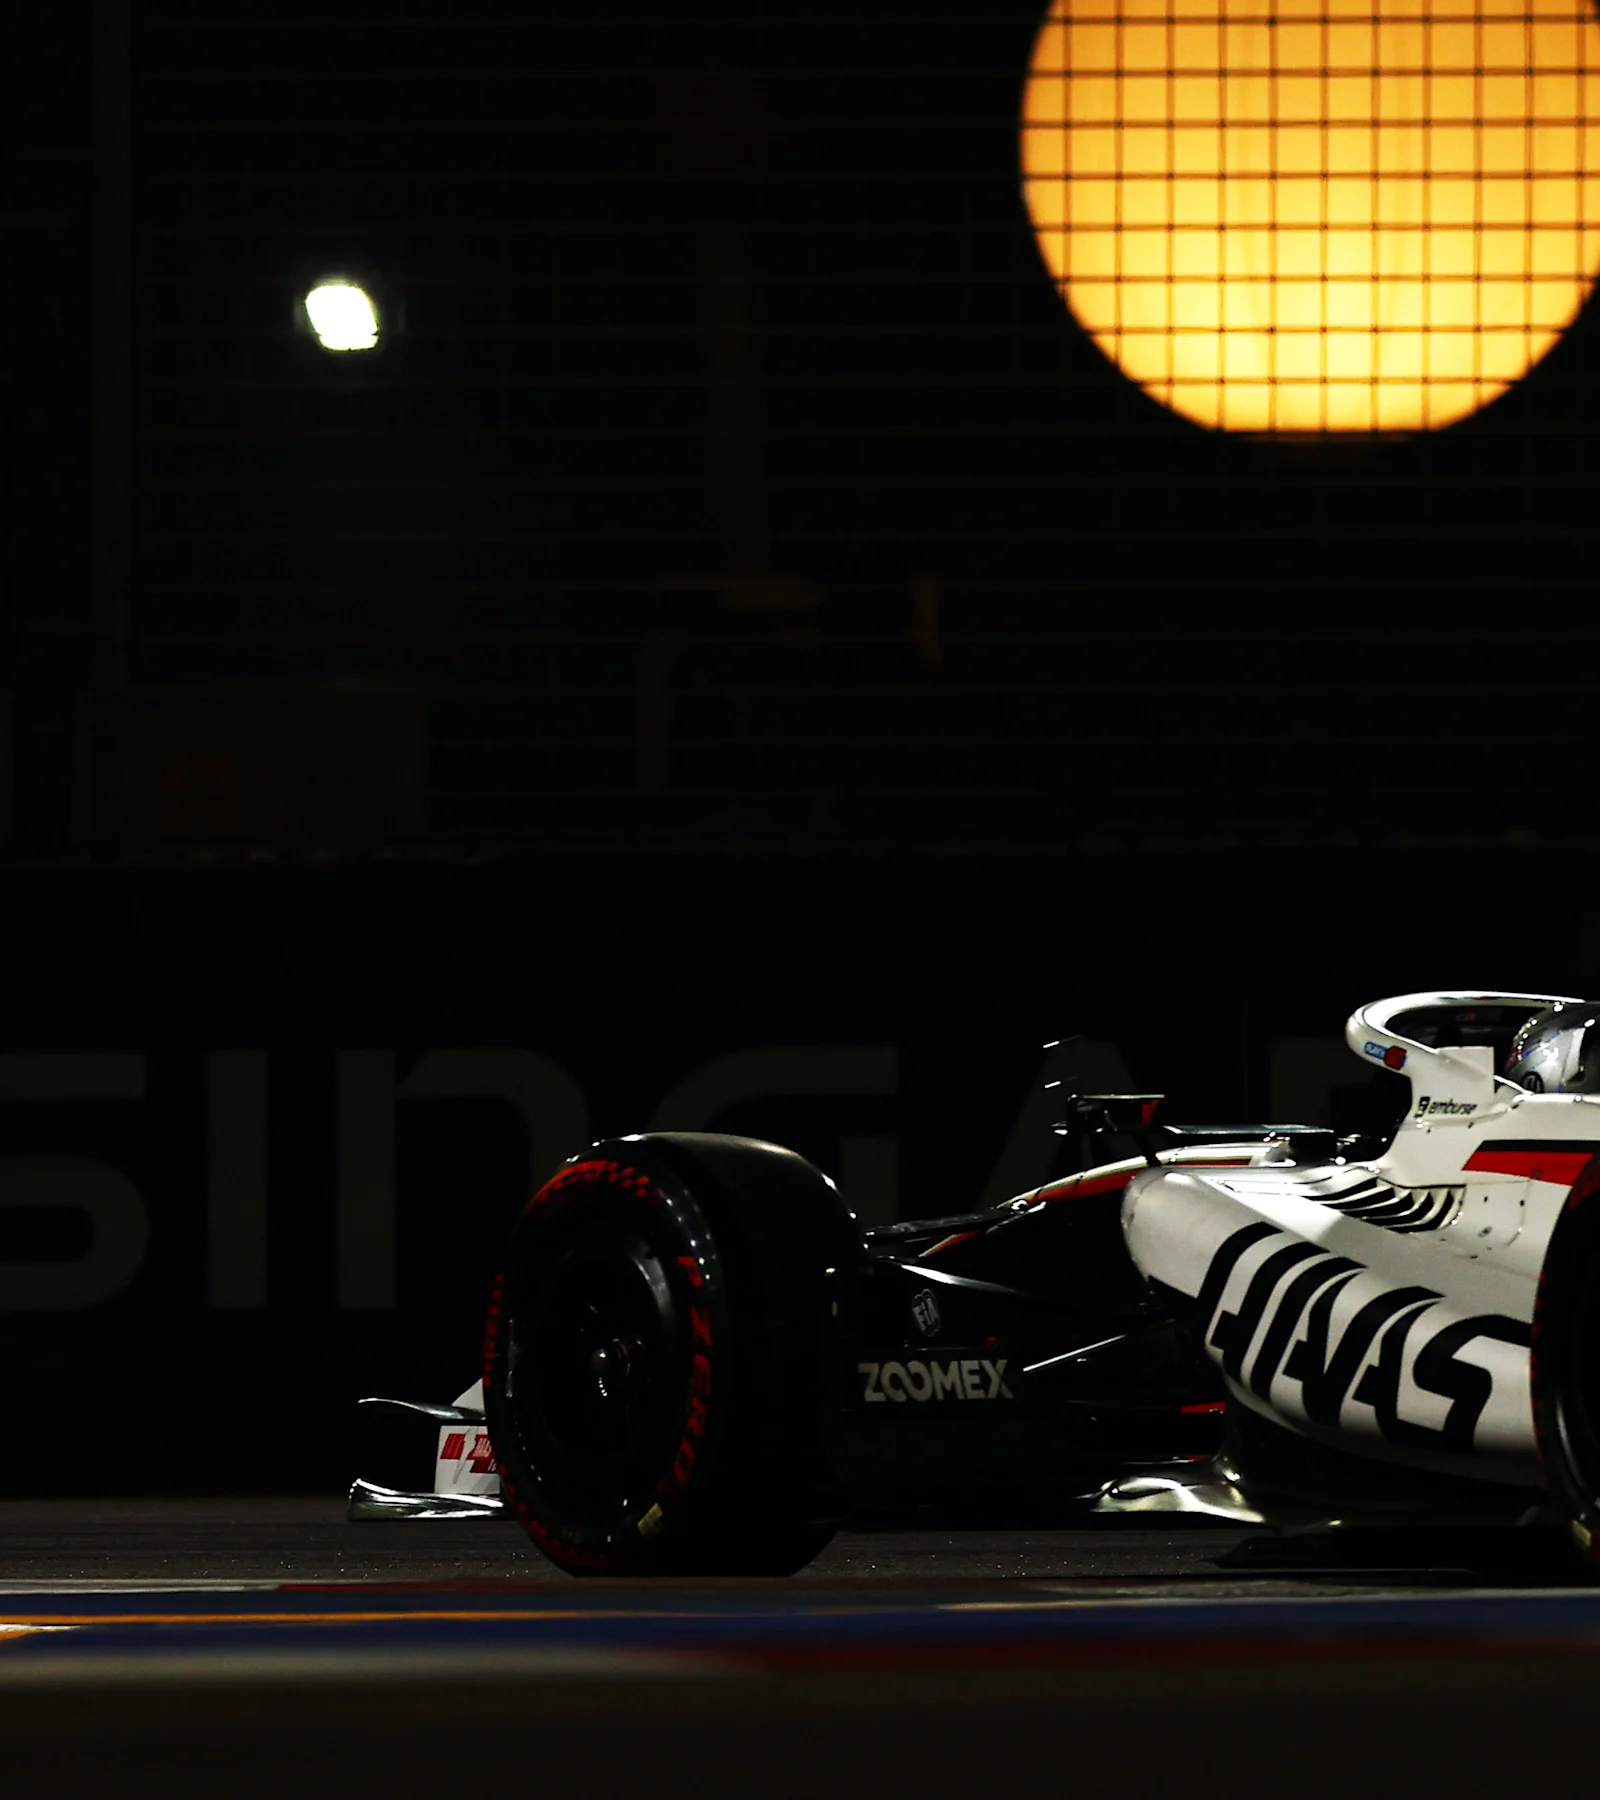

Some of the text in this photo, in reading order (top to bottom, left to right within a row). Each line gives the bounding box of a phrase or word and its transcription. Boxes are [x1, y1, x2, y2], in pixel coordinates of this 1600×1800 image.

[1428, 1098, 1477, 1116] emburse
[857, 1359, 1014, 1402] ZOOMEX
[1200, 1222, 1532, 1454] HAAS
[673, 1305, 713, 1485] ZERO
